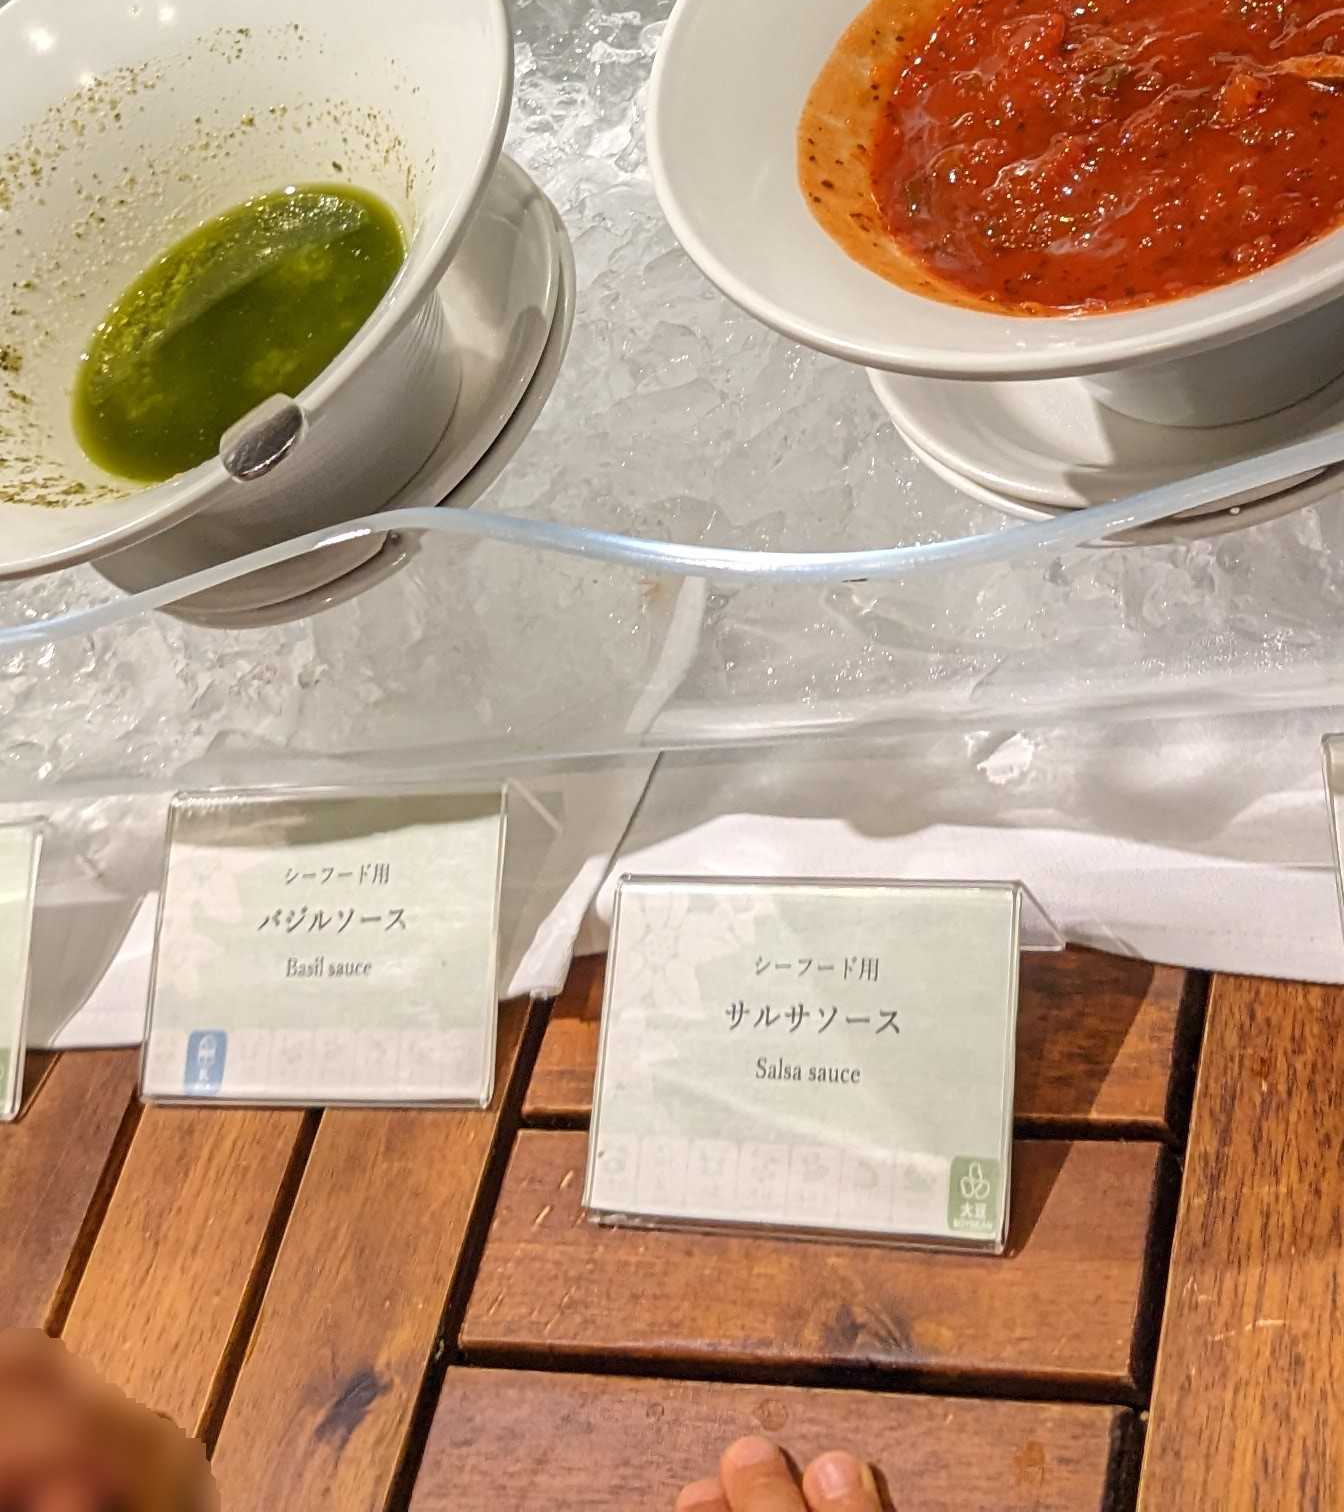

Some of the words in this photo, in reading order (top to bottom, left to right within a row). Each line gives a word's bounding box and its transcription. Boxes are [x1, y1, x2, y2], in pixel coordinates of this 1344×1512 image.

[286, 863, 391, 886] シーフード用
[257, 904, 407, 934] バジルソース
[285, 955, 325, 977] Basil
[327, 961, 372, 977] sauce
[755, 956, 880, 982] シーフード用
[725, 1000, 901, 1034] サルサソース
[755, 1057, 802, 1080] Salsa
[808, 1066, 861, 1084] sauce
